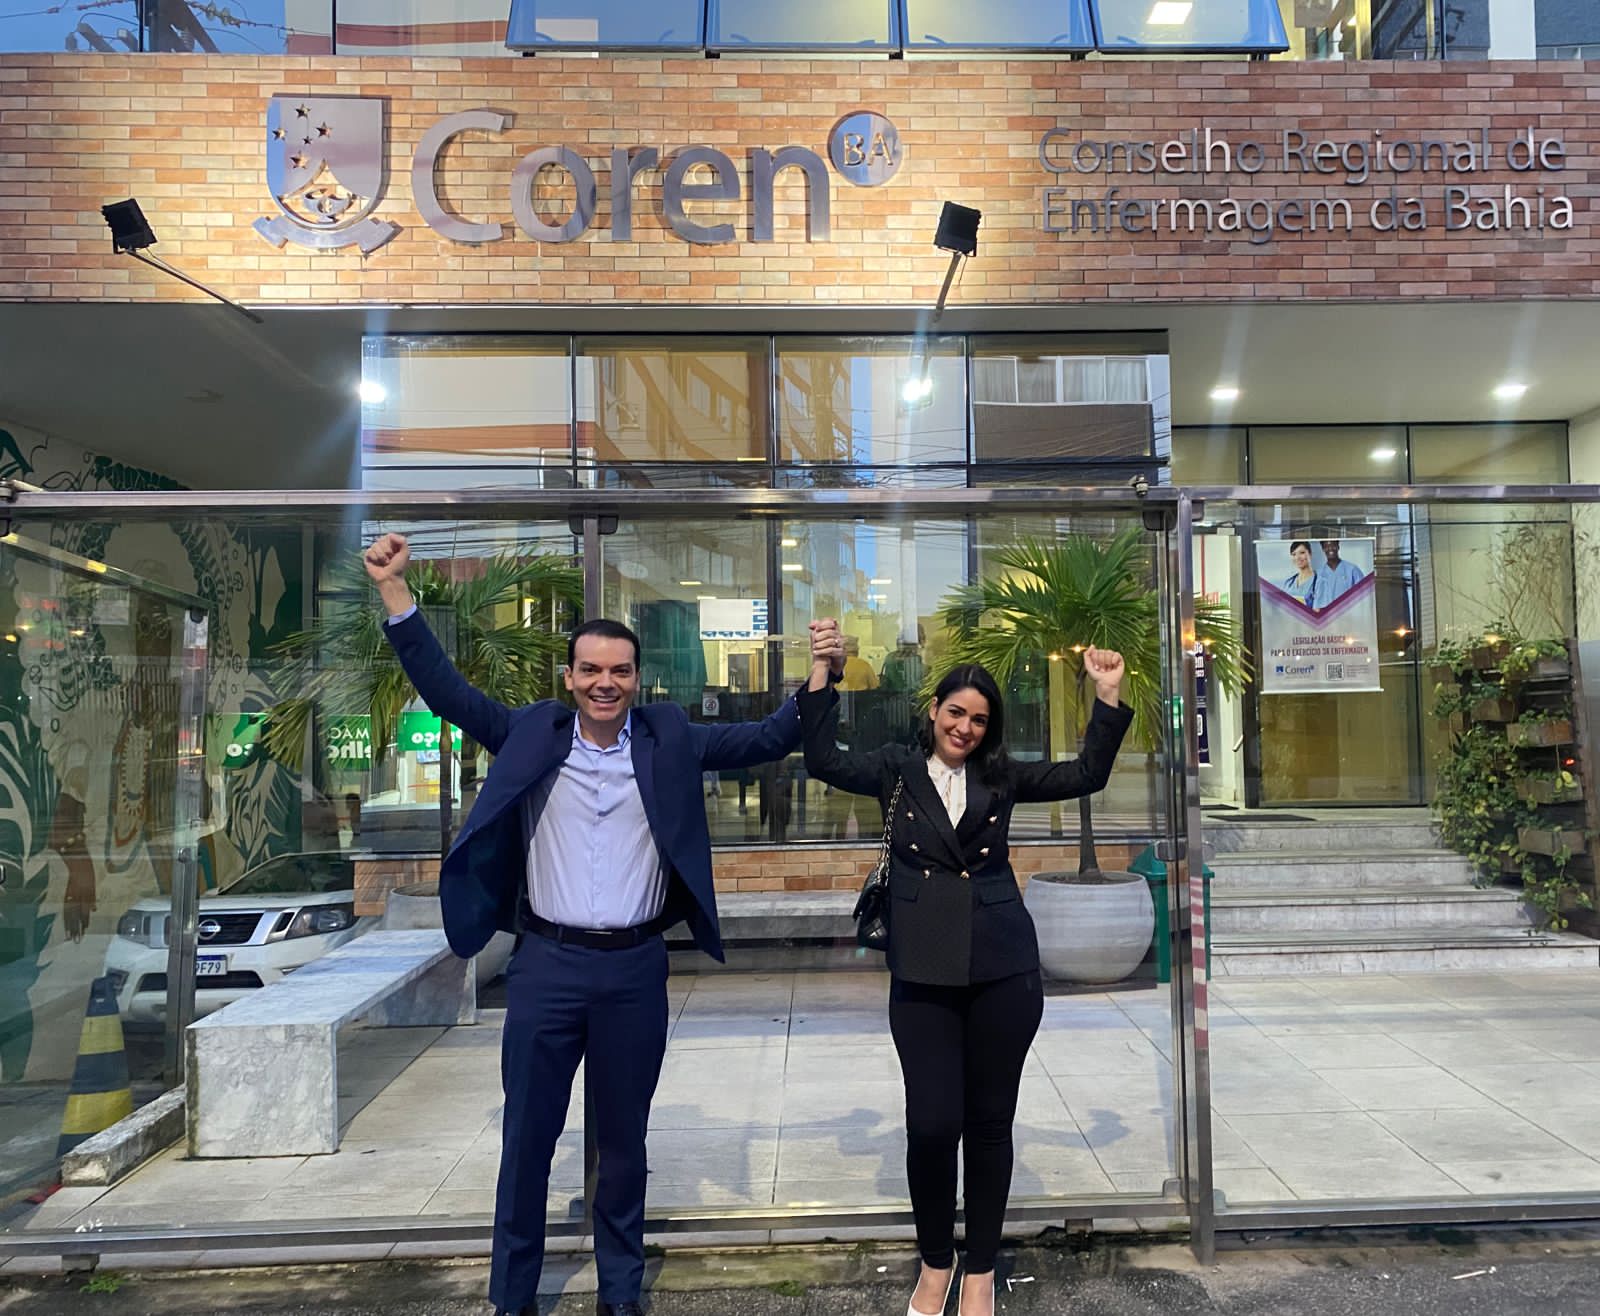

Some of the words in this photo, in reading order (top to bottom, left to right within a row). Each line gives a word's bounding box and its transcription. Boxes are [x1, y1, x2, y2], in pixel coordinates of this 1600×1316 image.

[412, 109, 830, 243] Coren
[843, 132, 895, 168] BA
[1039, 127, 1265, 174] Conselho
[1282, 127, 1489, 186] Regional
[1507, 125, 1567, 172] de
[1042, 187, 1352, 245] Enfermagem
[1370, 185, 1427, 232] da
[1445, 184, 1574, 231] Bahia
[1331, 646, 1369, 656] ENFERMAGEM
